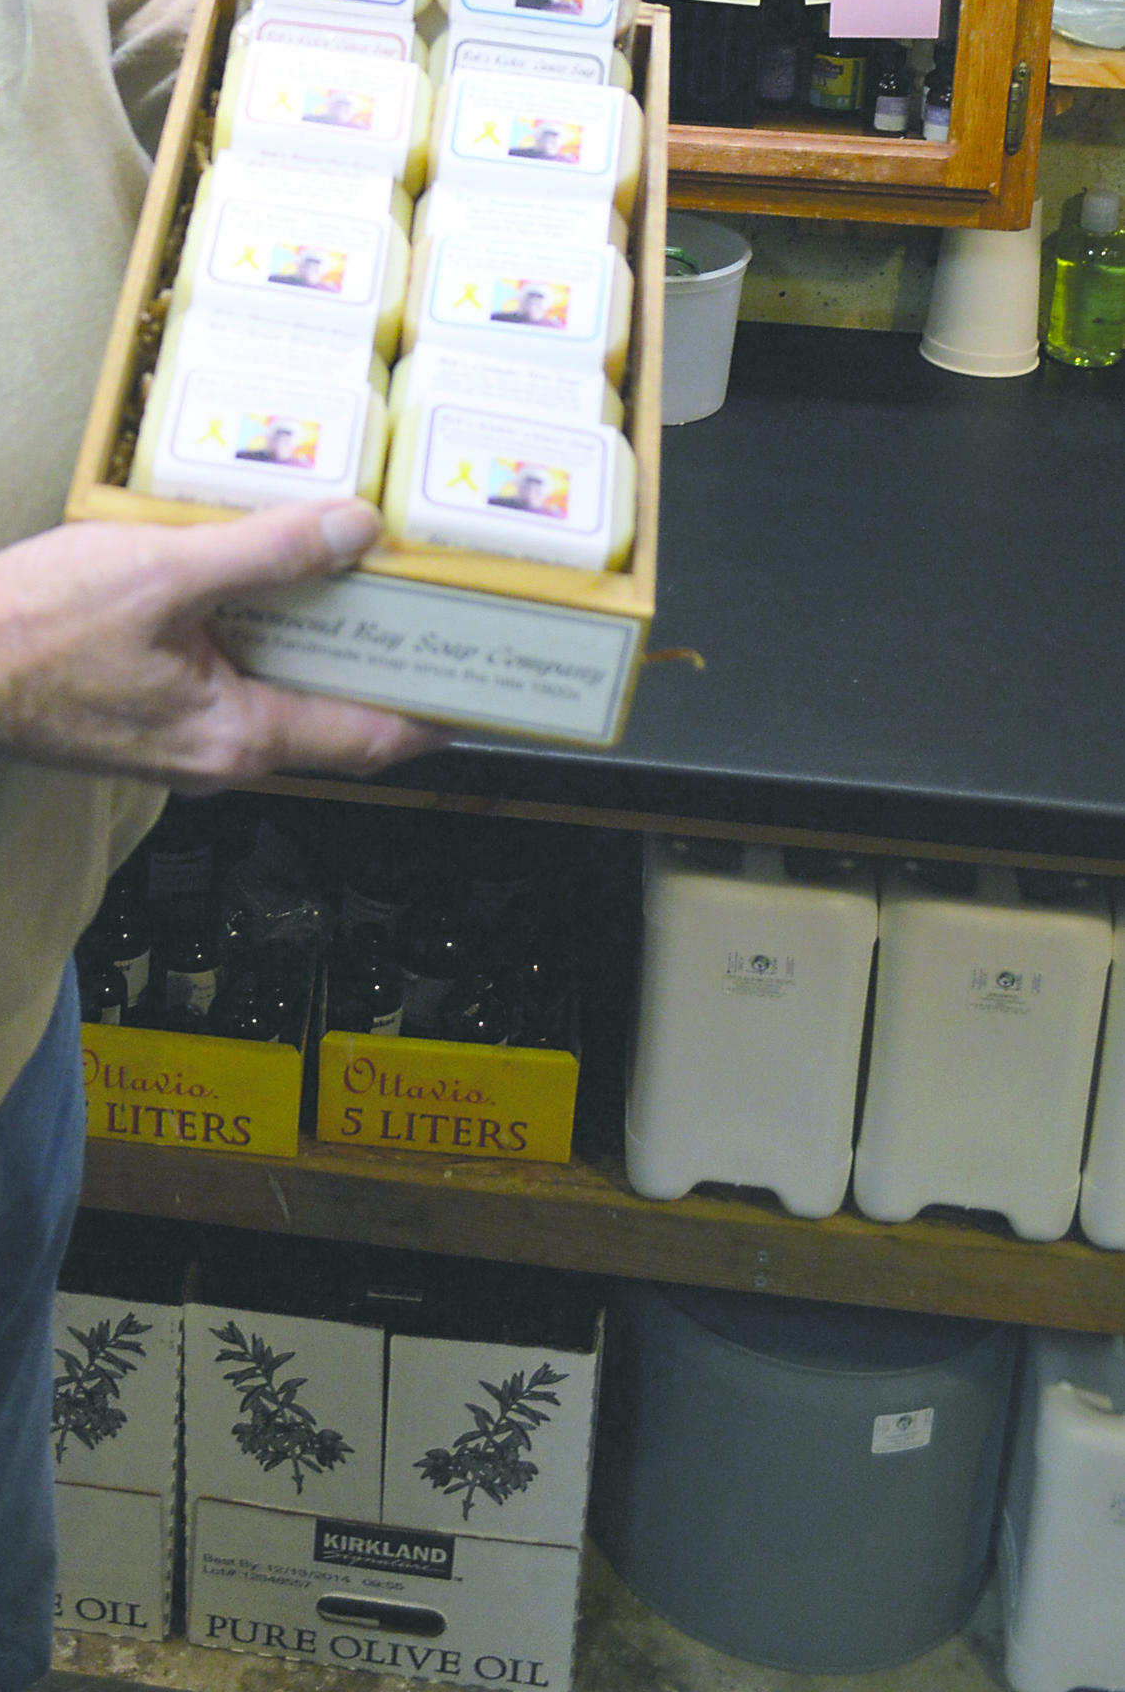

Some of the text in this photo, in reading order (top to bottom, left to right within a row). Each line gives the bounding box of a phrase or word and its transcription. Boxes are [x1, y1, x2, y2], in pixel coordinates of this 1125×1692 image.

[352, 621, 406, 650] Bay
[413, 631, 480, 661] Soap
[486, 643, 607, 687] Company
[106, 1102, 251, 1146] LITERS
[341, 1106, 529, 1152] 5 LITERS
[203, 1553, 235, 1566] Best
[324, 1532, 447, 1564] KIRKLAND
[75, 1596, 148, 1629] OIL
[206, 1613, 550, 1689] PURE OLIVE OIL
